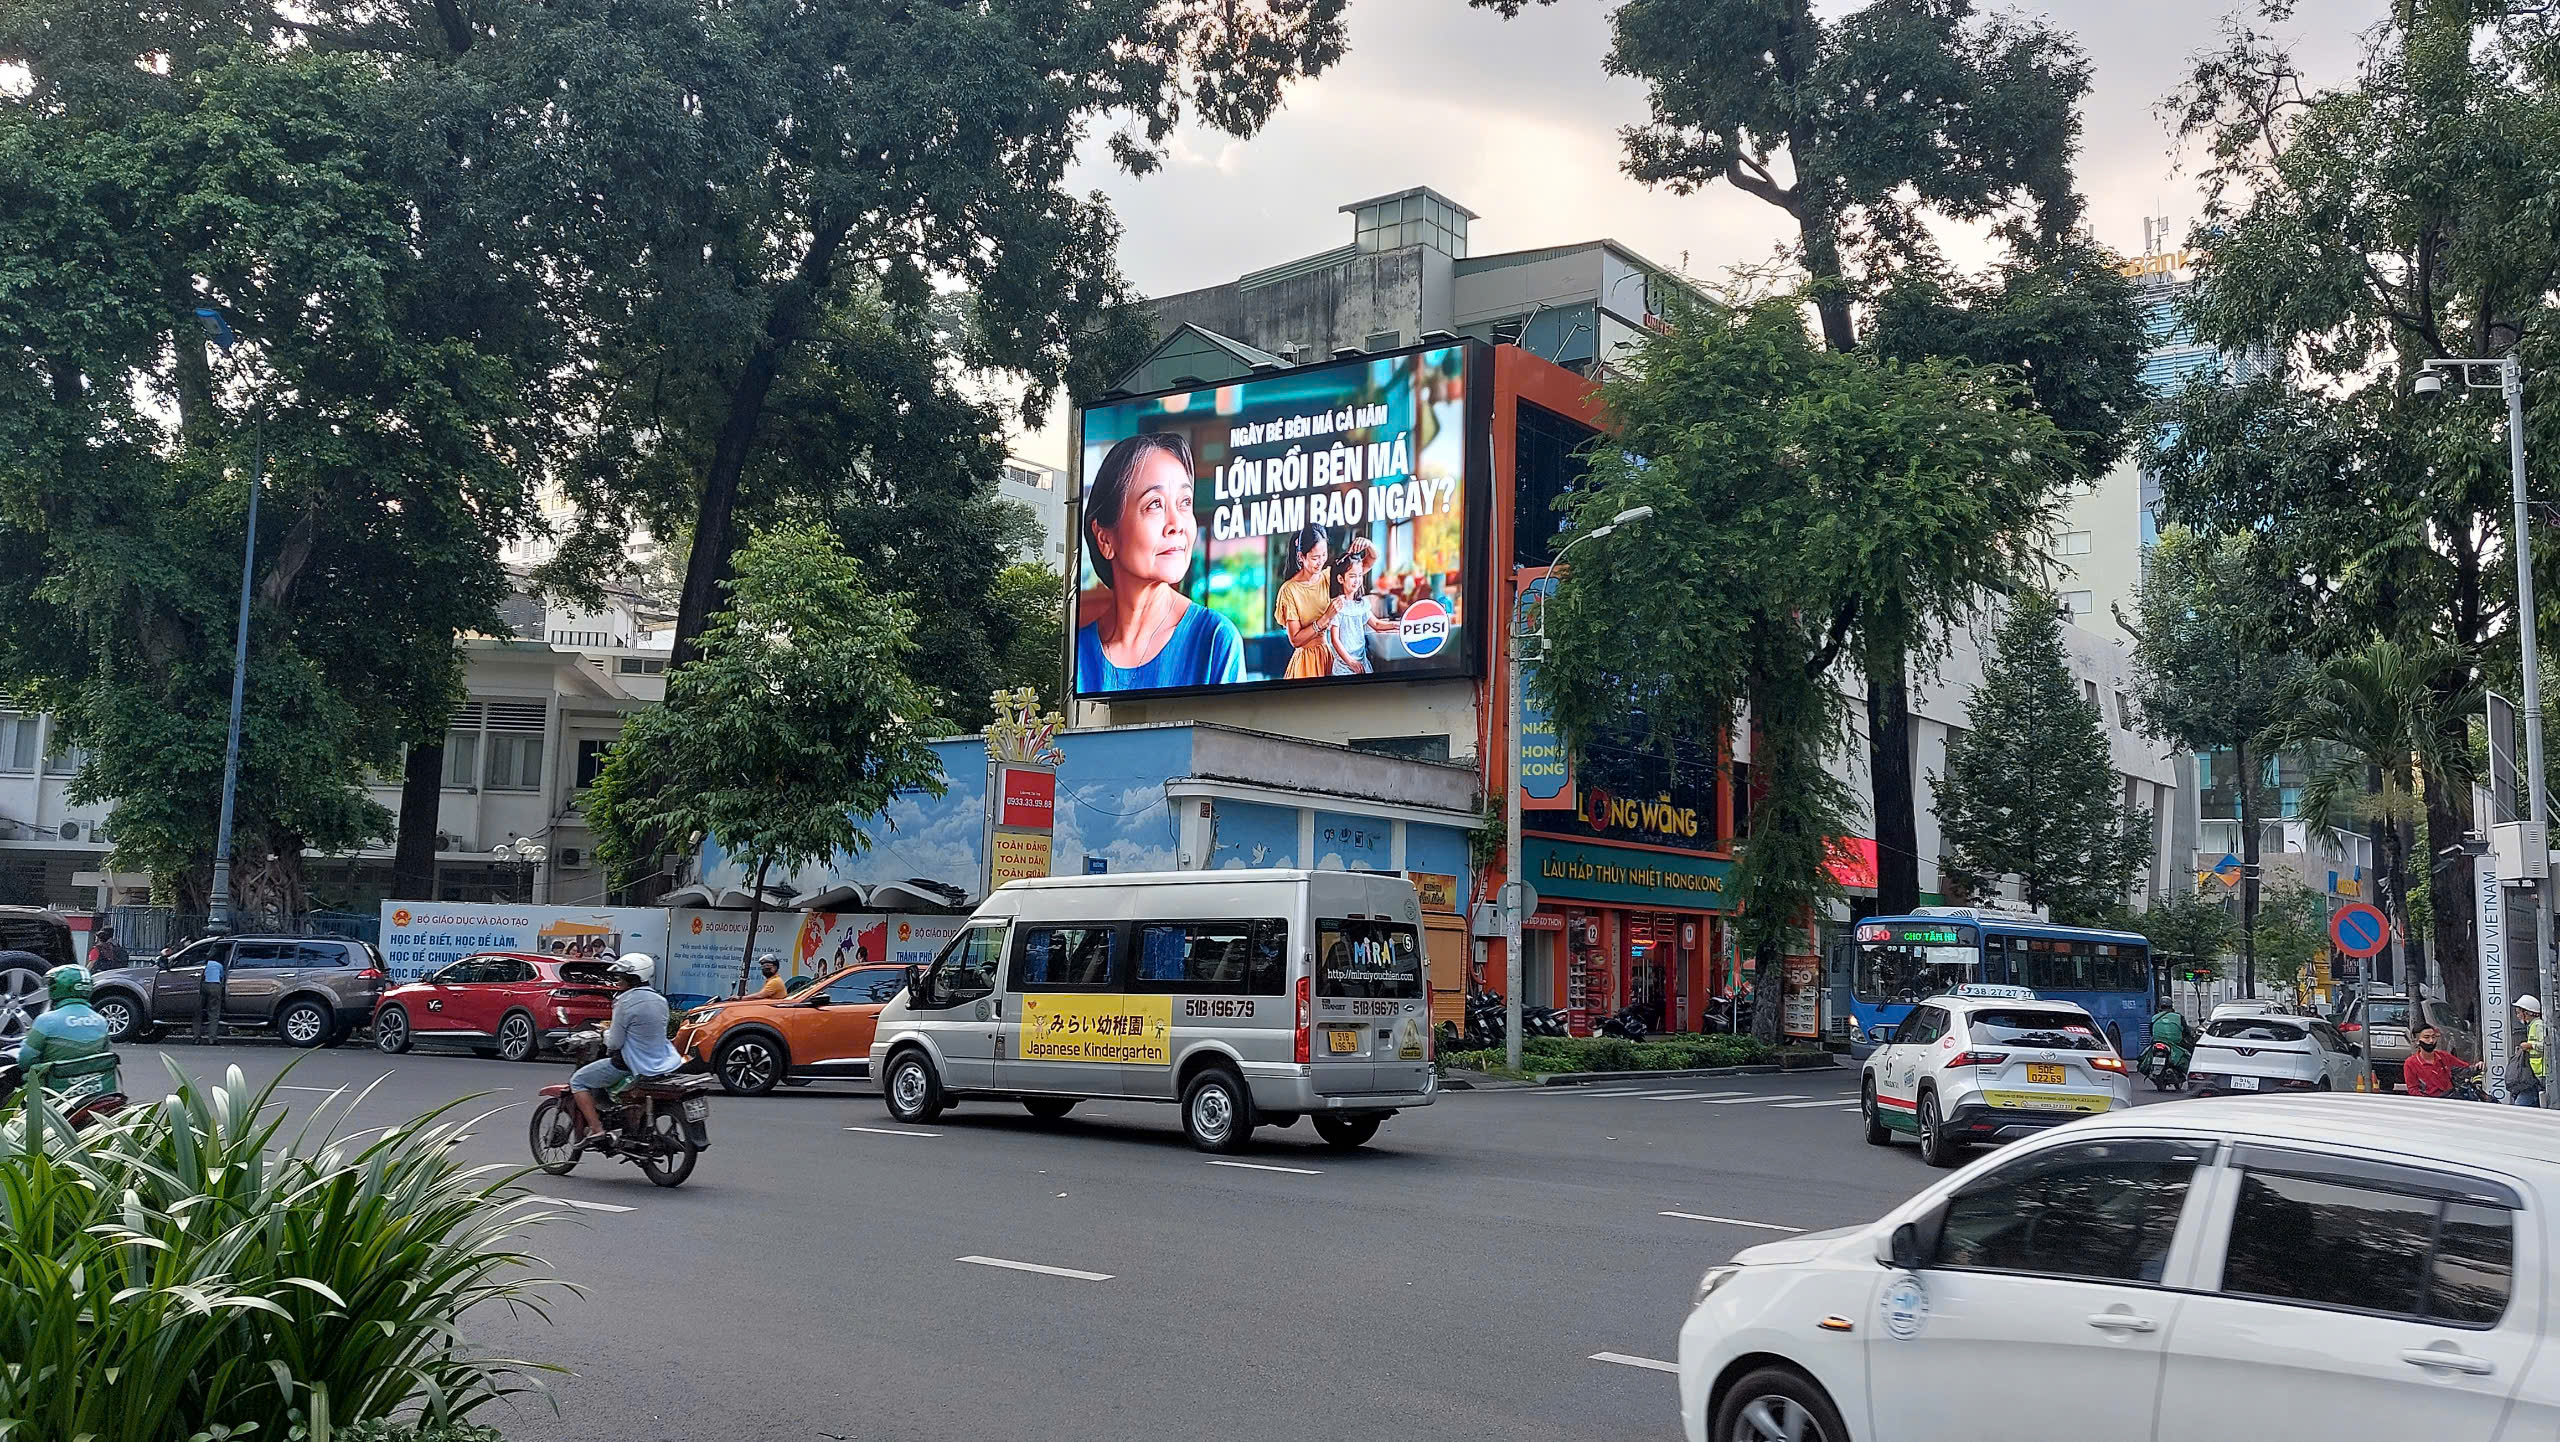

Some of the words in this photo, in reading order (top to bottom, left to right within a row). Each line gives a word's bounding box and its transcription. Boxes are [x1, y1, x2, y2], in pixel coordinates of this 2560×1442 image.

[1230, 422, 1265, 448] NGÀY
[1266, 417, 1284, 443] BÉ
[1284, 414, 1310, 440] BÊN
[1312, 410, 1334, 436] MÁ
[1335, 404, 1355, 432] CẢ
[1356, 403, 1388, 428] NĂM
[1214, 456, 1262, 501] LỚN
[1266, 445, 1308, 494] RỒI
[1313, 441, 1363, 488] BÊN
[1368, 430, 1409, 480] MÁ
[1213, 498, 1247, 541] CẢ
[1250, 493, 1305, 537] NĂM
[1309, 488, 1363, 528] BAO
[1368, 474, 1456, 523] NGÀY?
[1404, 622, 1445, 635] PEPSI
[1522, 745, 1565, 758] HONG
[1522, 763, 1565, 776] KONG
[1577, 786, 1639, 832] LONG
[997, 840, 1023, 850] TOÀN
[1025, 841, 1049, 853] ĐẢNG,
[1000, 854, 1026, 864] TOÀN
[1028, 855, 1046, 866] DÂN,
[997, 867, 1024, 877] TOÀN
[1543, 850, 1566, 878] LẨU
[1569, 854, 1593, 879] HẤP
[1596, 861, 1626, 884] THỦY
[1629, 864, 1661, 891] NHIỆT
[1664, 873, 1723, 893] HONGKONG
[2483, 870, 2499, 940] VIETNAM
[417, 914, 430, 926] BỘ
[432, 914, 454, 924] GIÁO
[456, 916, 475, 926] DỤC
[476, 914, 488, 925] VÀ
[490, 914, 509, 925] ĐÀO
[511, 918, 528, 928] TẠO
[714, 923, 729, 932] GIÁO
[730, 924, 741, 934] DỤC
[914, 927, 924, 938] BỘ
[925, 927, 942, 938] GIÁO
[1590, 927, 1597, 938] 12
[1687, 927, 1692, 938] 11
[1857, 926, 1871, 941] 30
[1872, 930, 1891, 941] 30
[390, 934, 410, 947] HỌC
[413, 931, 428, 945] ĐỂ
[429, 932, 452, 946] BIẾT,
[455, 935, 475, 948] HỌC
[478, 932, 491, 946] ĐỂ
[494, 935, 518, 948] LÀM,
[389, 951, 409, 963] HỌC
[412, 948, 426, 962] ĐỂ
[428, 952, 462, 963] CHUNG
[896, 950, 918, 962] THÀNH
[920, 948, 933, 962] PHỐ
[1791, 970, 1812, 983] 50
[2486, 943, 2502, 1006] SHIMIZU
[65, 1014, 100, 1027] Grab
[1049, 1013, 1144, 1037] みらい幼稚園
[1337, 1033, 1350, 1041] 51B
[1027, 1041, 1080, 1058] Japanese
[1084, 1042, 1162, 1062] Kindergarten
[2032, 1074, 2062, 1083] 022.69
